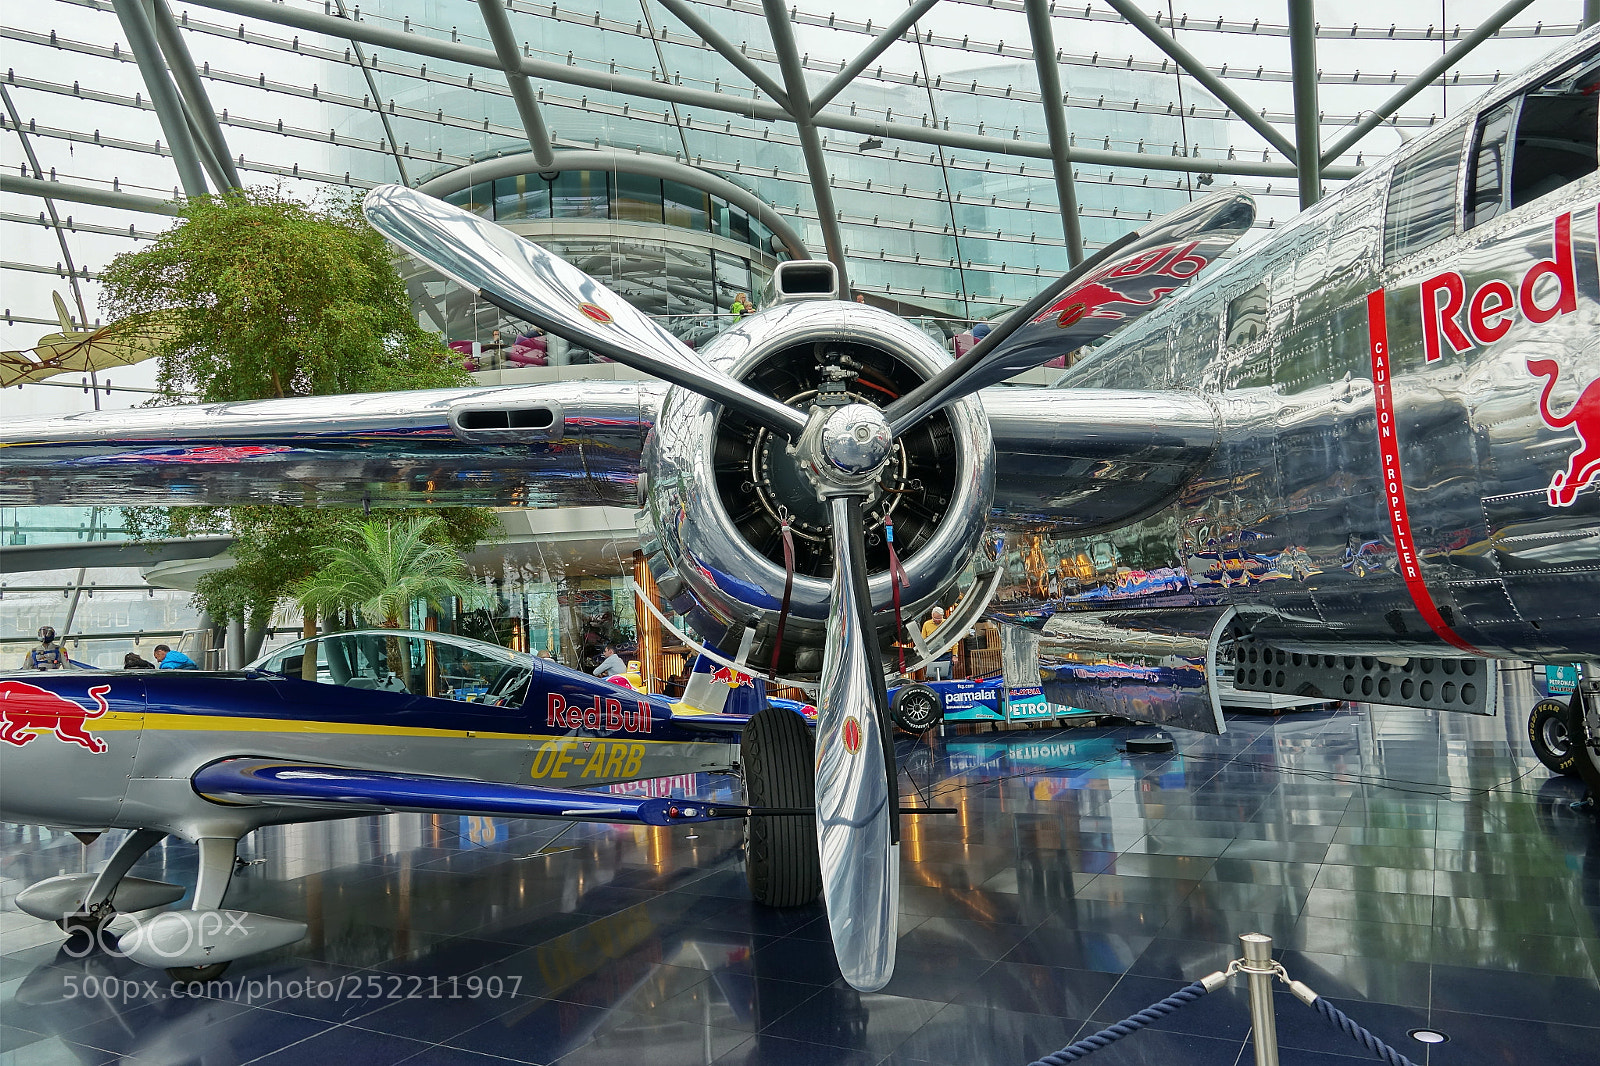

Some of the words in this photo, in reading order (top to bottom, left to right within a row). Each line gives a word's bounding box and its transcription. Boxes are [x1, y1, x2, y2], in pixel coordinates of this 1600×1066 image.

[1420, 211, 1577, 365] Red
[1375, 342, 1390, 438] CAUTION
[1385, 454, 1416, 578] PROPELLER
[547, 693, 601, 730] Red
[605, 698, 652, 734] Bull
[945, 689, 996, 705] parmalat
[530, 742, 646, 779] OE-ARB
